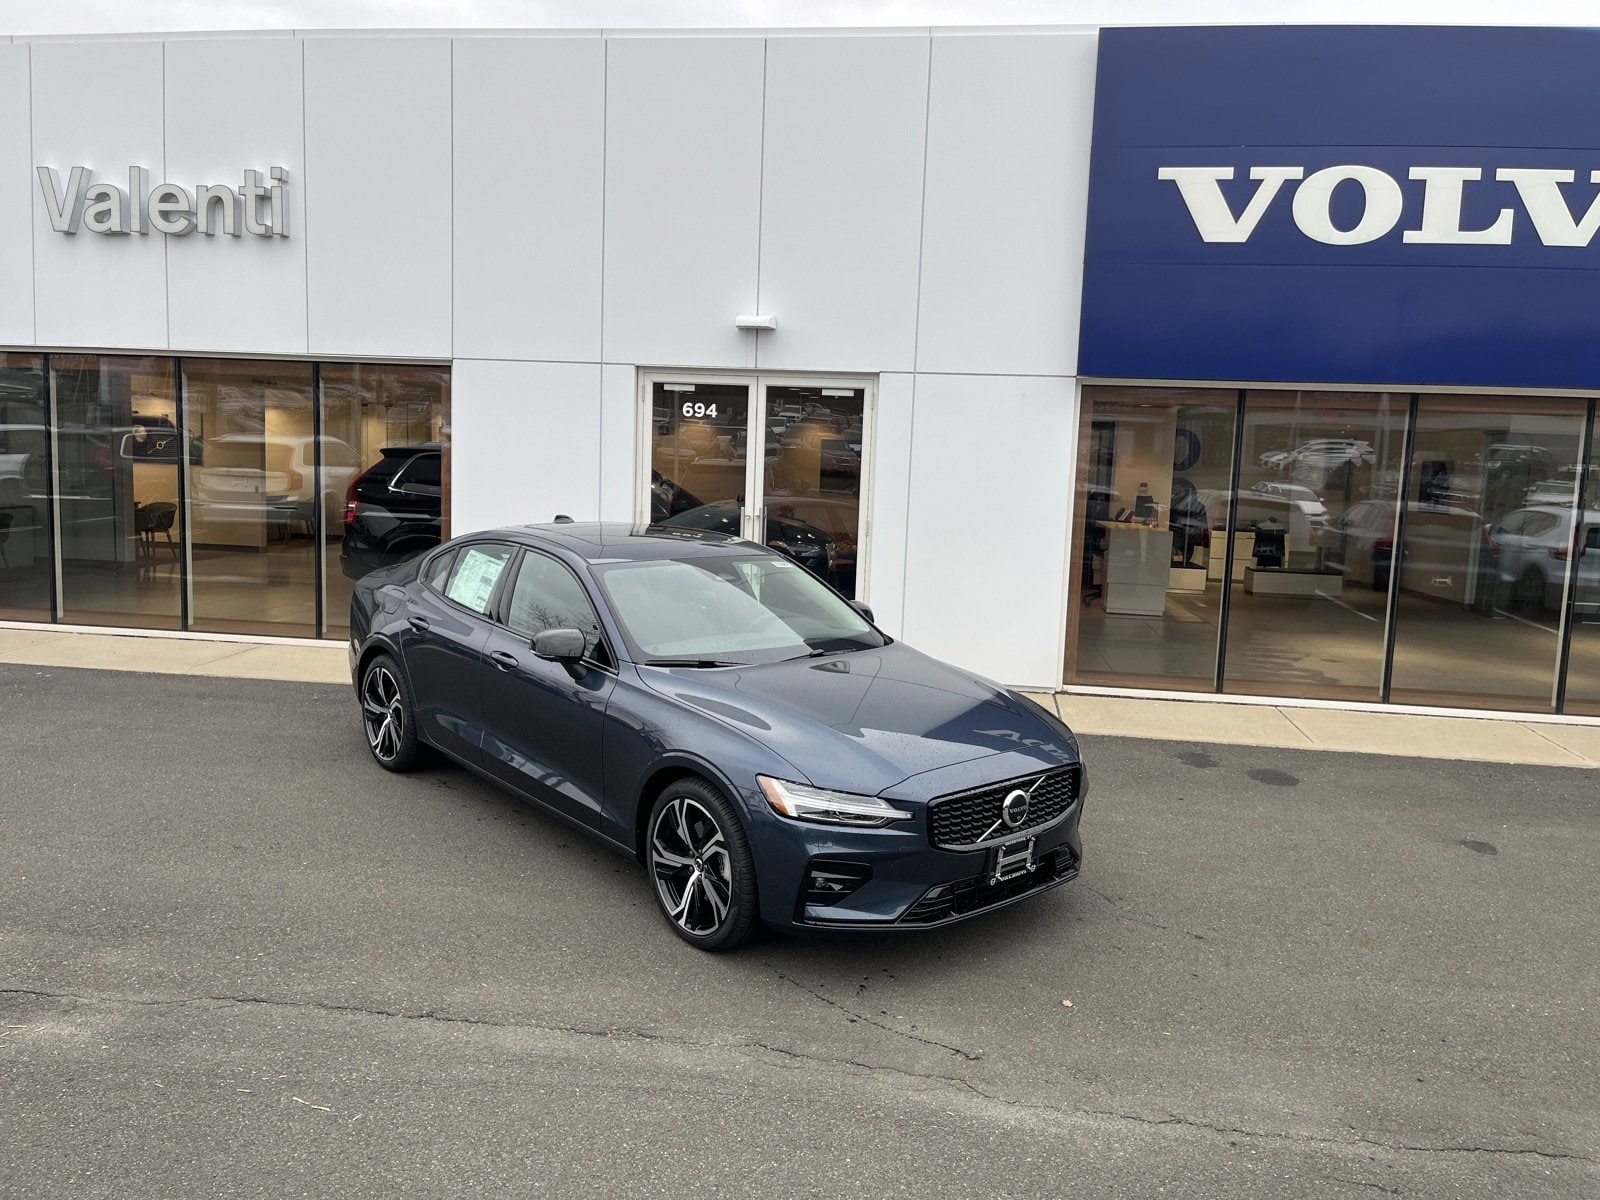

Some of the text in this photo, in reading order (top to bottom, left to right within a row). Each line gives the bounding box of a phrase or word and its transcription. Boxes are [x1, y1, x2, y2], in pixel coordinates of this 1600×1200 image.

[36, 165, 289, 238] Valenti
[1158, 165, 1600, 247] VOLV
[682, 402, 718, 418] 694
